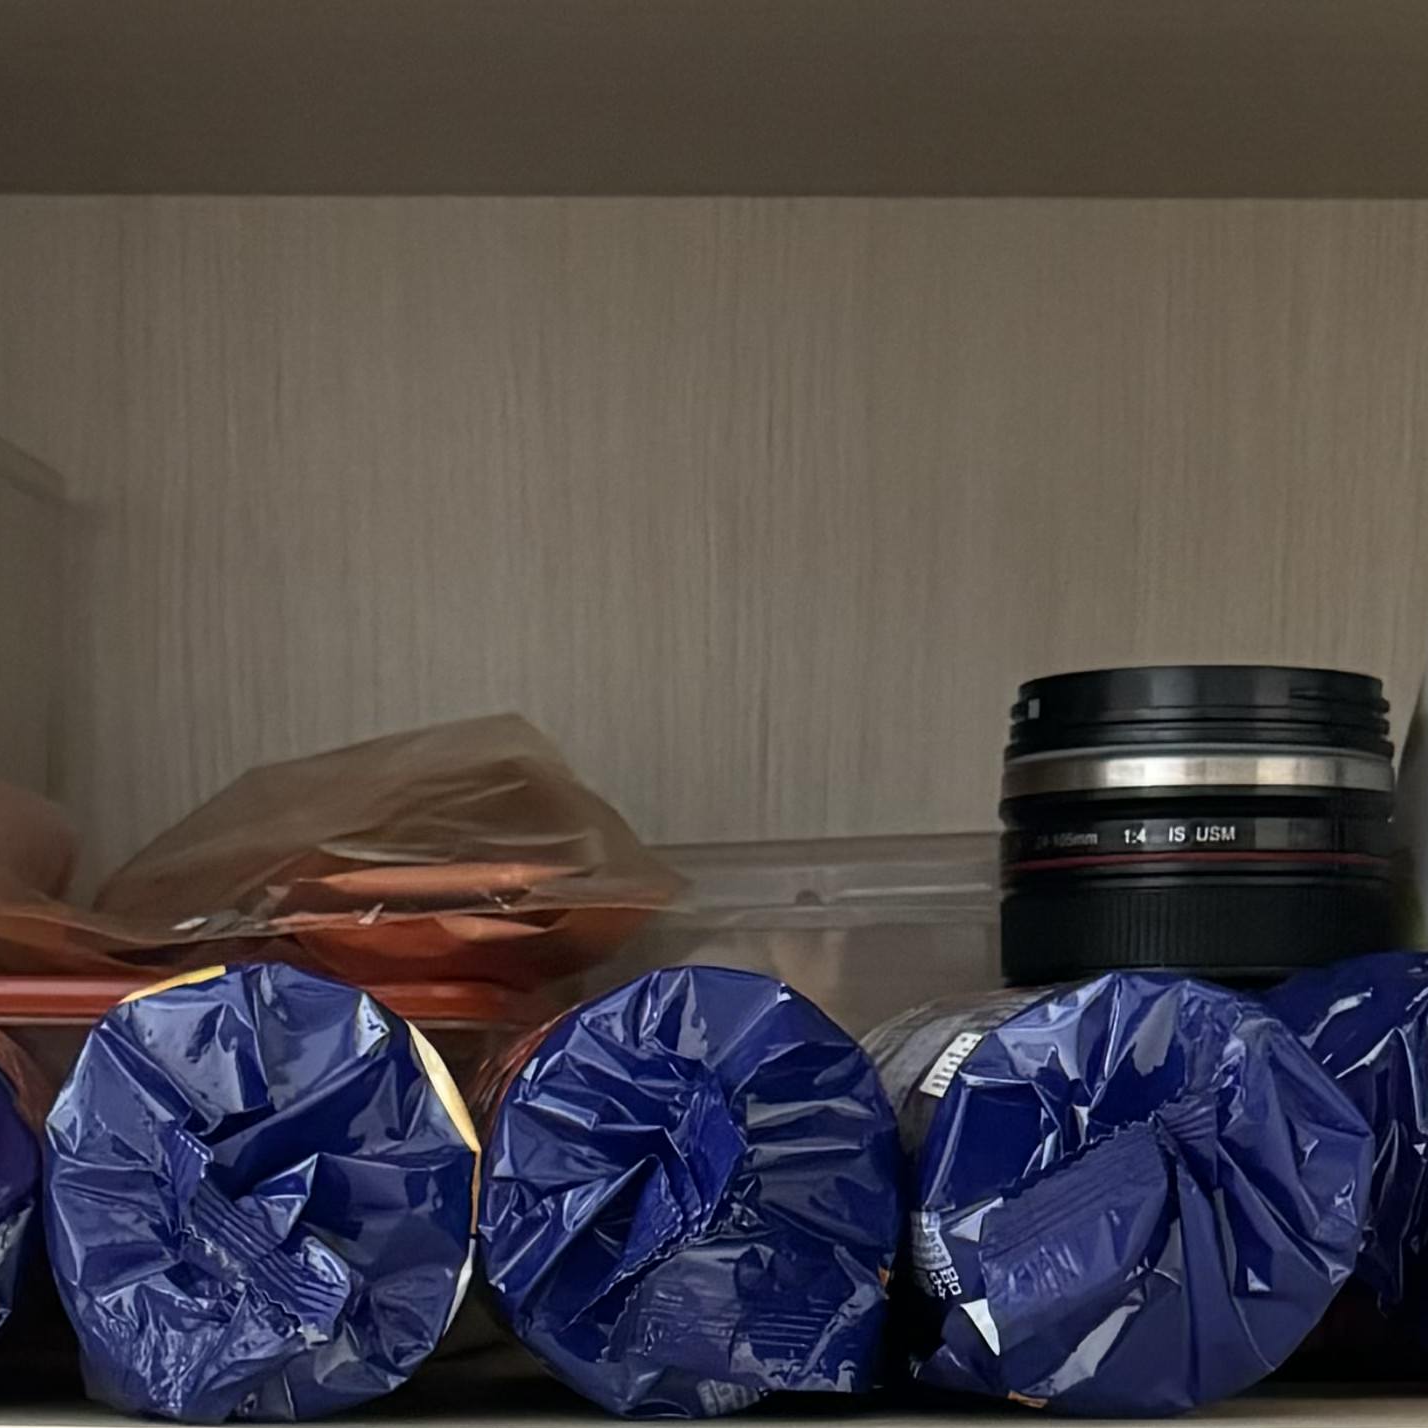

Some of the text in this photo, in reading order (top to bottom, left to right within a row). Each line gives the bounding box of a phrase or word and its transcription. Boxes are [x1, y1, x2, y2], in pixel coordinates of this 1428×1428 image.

[1123, 829, 1147, 845] 1:4
[1168, 826, 1186, 843] IS
[1195, 825, 1236, 842] USM
